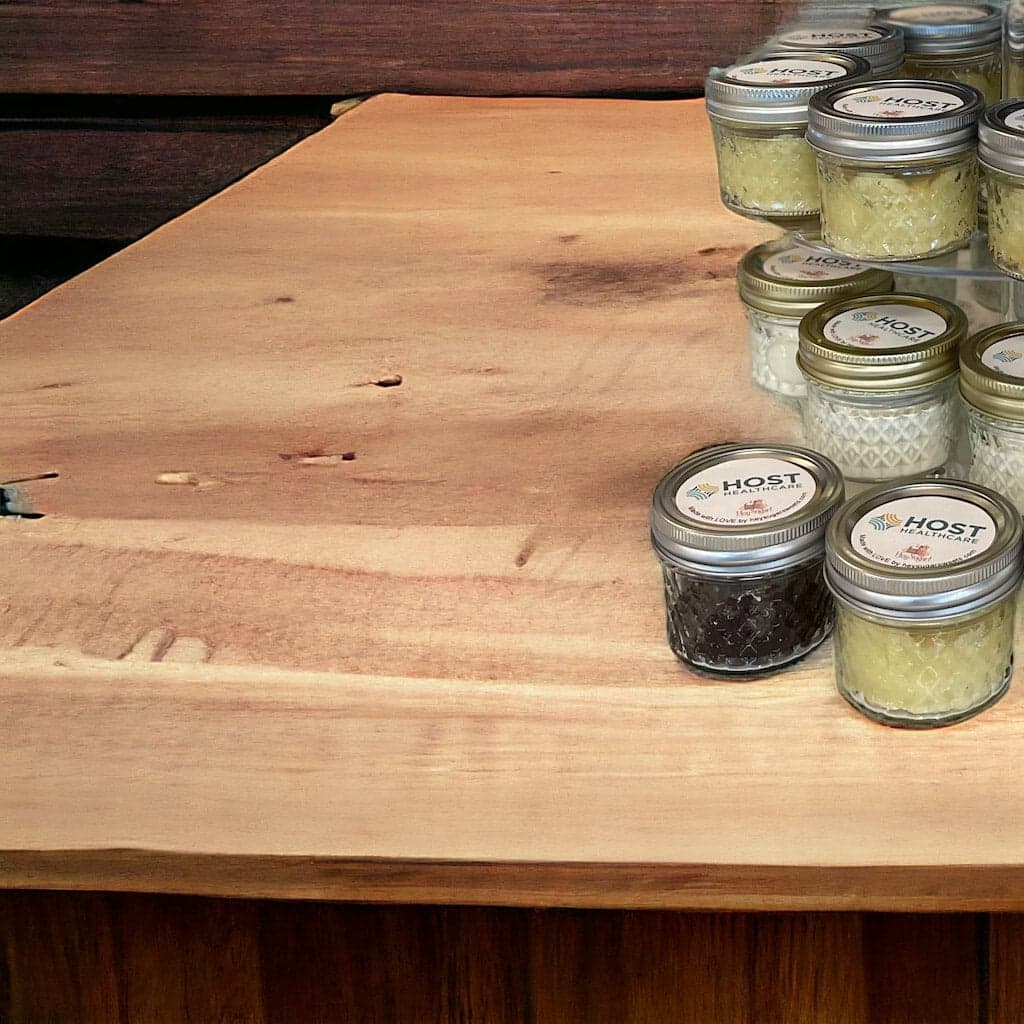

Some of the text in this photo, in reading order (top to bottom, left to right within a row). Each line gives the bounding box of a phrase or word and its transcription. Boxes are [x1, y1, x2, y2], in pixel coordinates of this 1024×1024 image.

[769, 68, 839, 76] HOST
[884, 97, 958, 109] HOST
[875, 316, 936, 338] HOST
[723, 473, 801, 491] HOST
[723, 483, 803, 497] HEALTHCARE
[900, 527, 980, 545] HEALTHCARE
[904, 516, 987, 538] HOST
